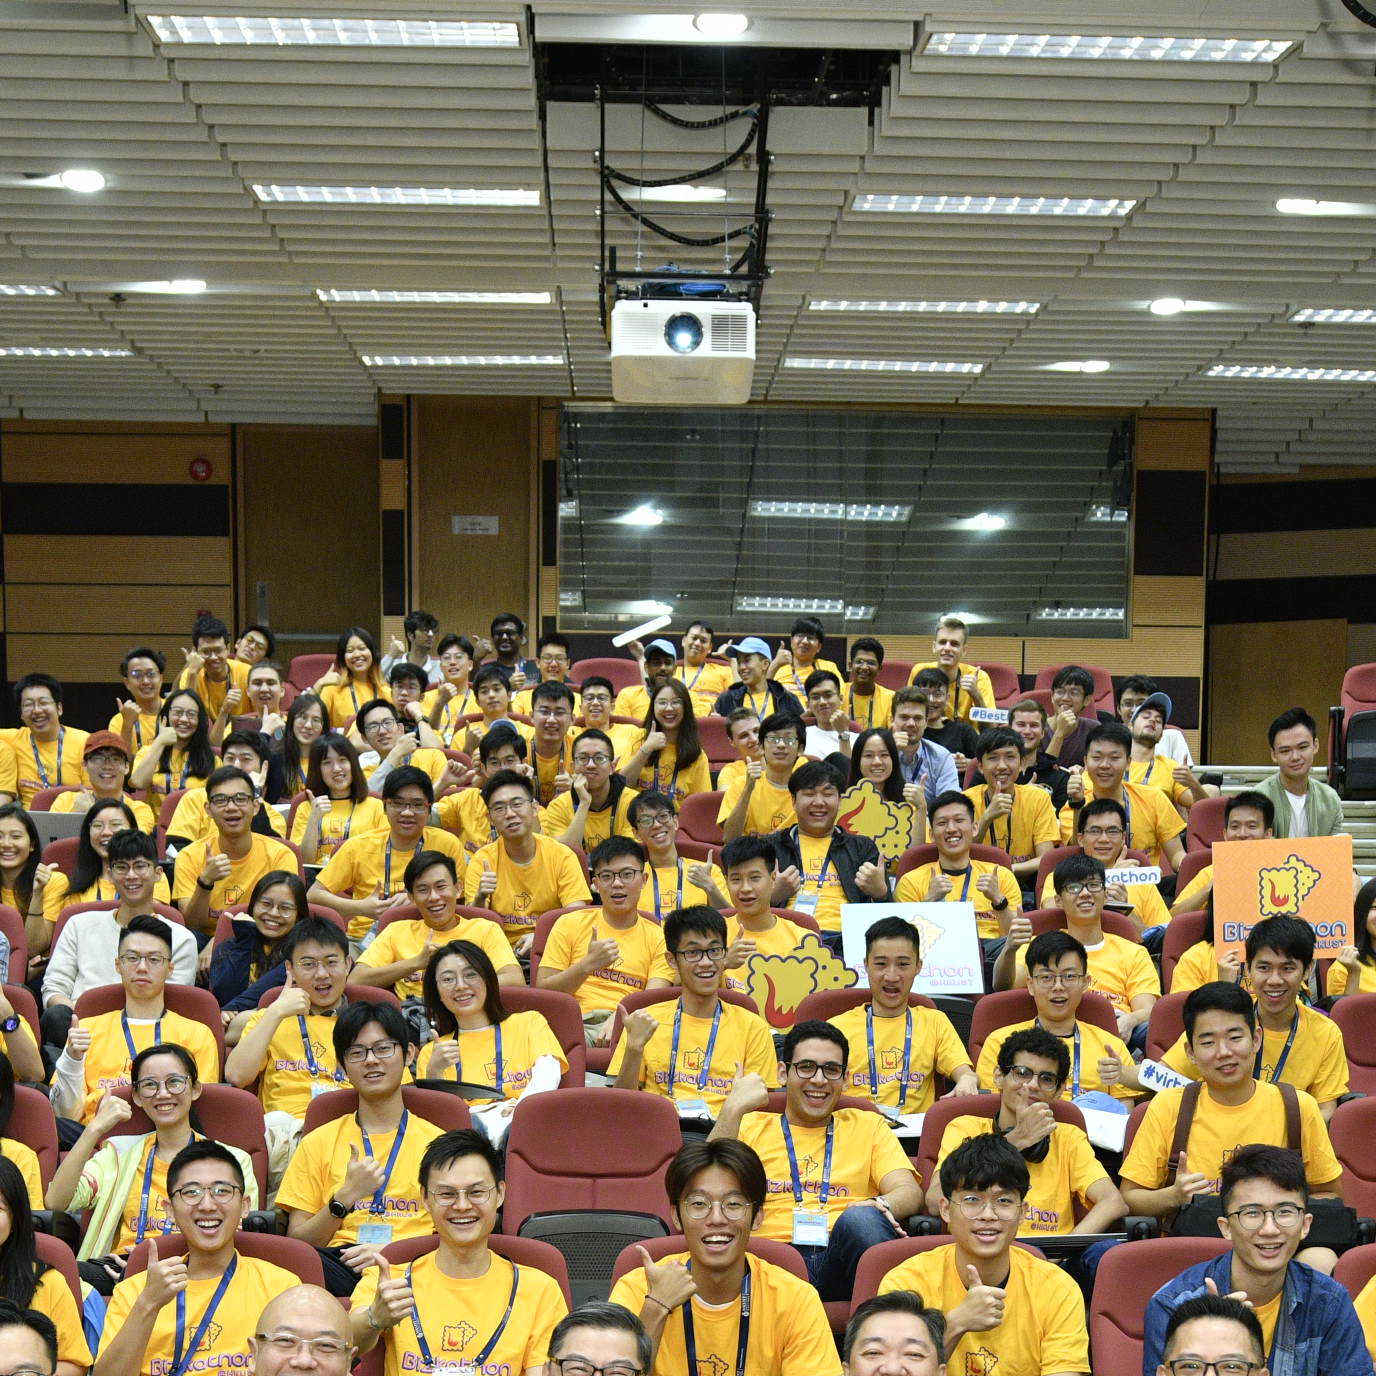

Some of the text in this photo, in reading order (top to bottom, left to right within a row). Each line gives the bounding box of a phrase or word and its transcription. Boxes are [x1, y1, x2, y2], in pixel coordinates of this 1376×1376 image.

[971, 709, 1010, 721] #Best
[592, 967, 646, 989] kathon
[1143, 1064, 1186, 1089] #virt
